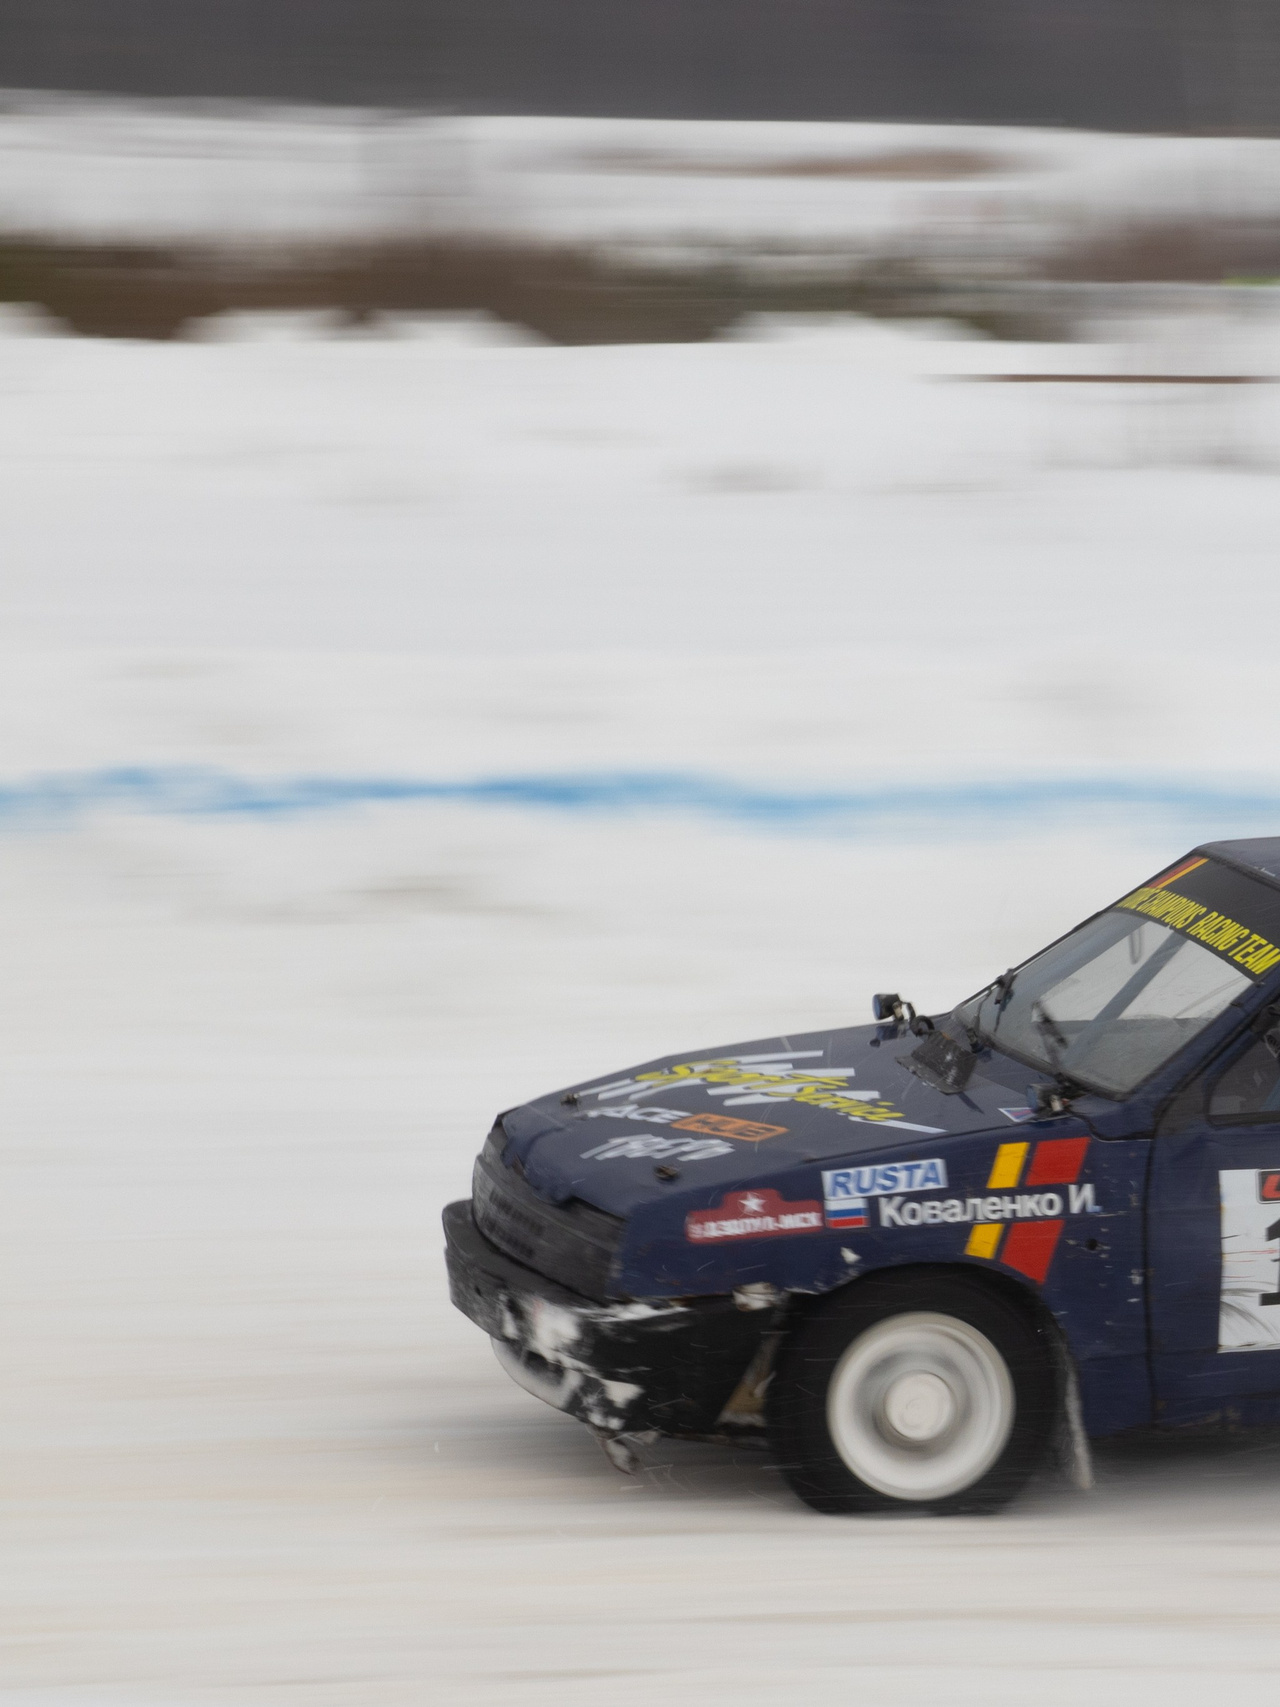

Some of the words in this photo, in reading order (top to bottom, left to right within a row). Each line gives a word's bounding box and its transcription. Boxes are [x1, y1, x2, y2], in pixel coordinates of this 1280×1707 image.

[1136, 890, 1207, 929] CHAMPIONS
[1186, 911, 1250, 951] RACING
[828, 1161, 944, 1199] RUSTA
[879, 1192, 1063, 1227] Коваленко
